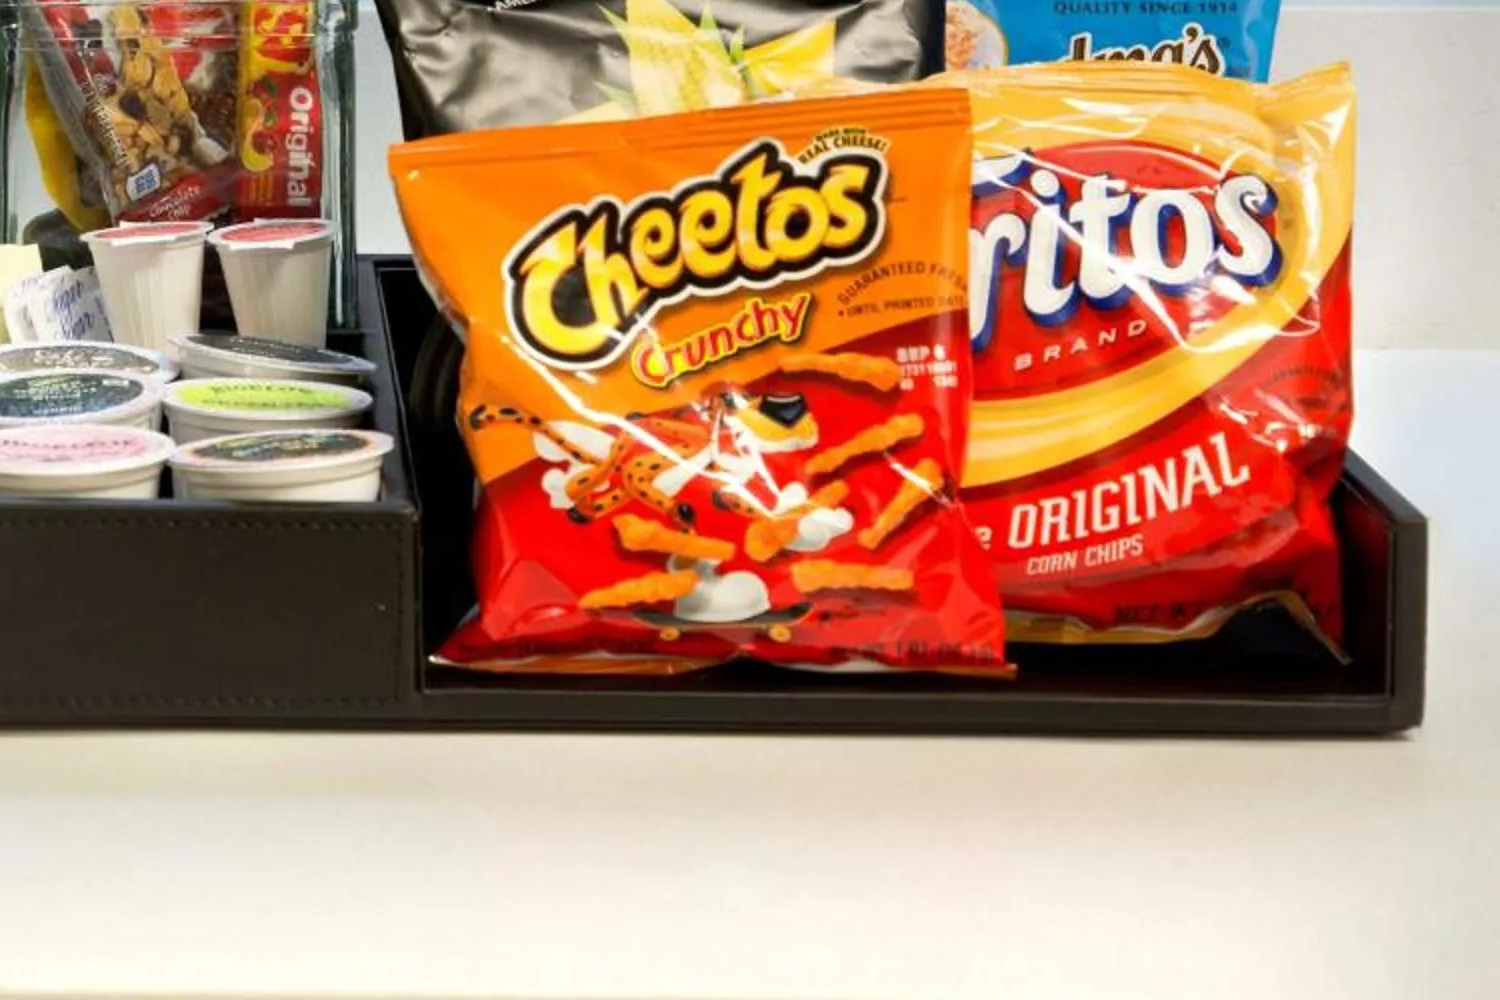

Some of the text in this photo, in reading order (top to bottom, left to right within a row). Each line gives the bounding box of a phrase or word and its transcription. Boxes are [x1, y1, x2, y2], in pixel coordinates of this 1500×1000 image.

[1054, 0, 1238, 16] QUALITY SINCE 1914
[284, 86, 316, 208] Original
[797, 135, 887, 164] REAL CHEESE!
[505, 142, 886, 367] Cheetos
[971, 149, 1282, 354] ritos
[837, 260, 927, 306] GUARANTEED
[884, 297, 935, 311] PRINTED
[631, 291, 815, 387] Crunchy
[1014, 317, 1149, 370] BRAND
[1007, 431, 1250, 550] ORIGINAL
[1026, 532, 1145, 576] CORN CHIPS
